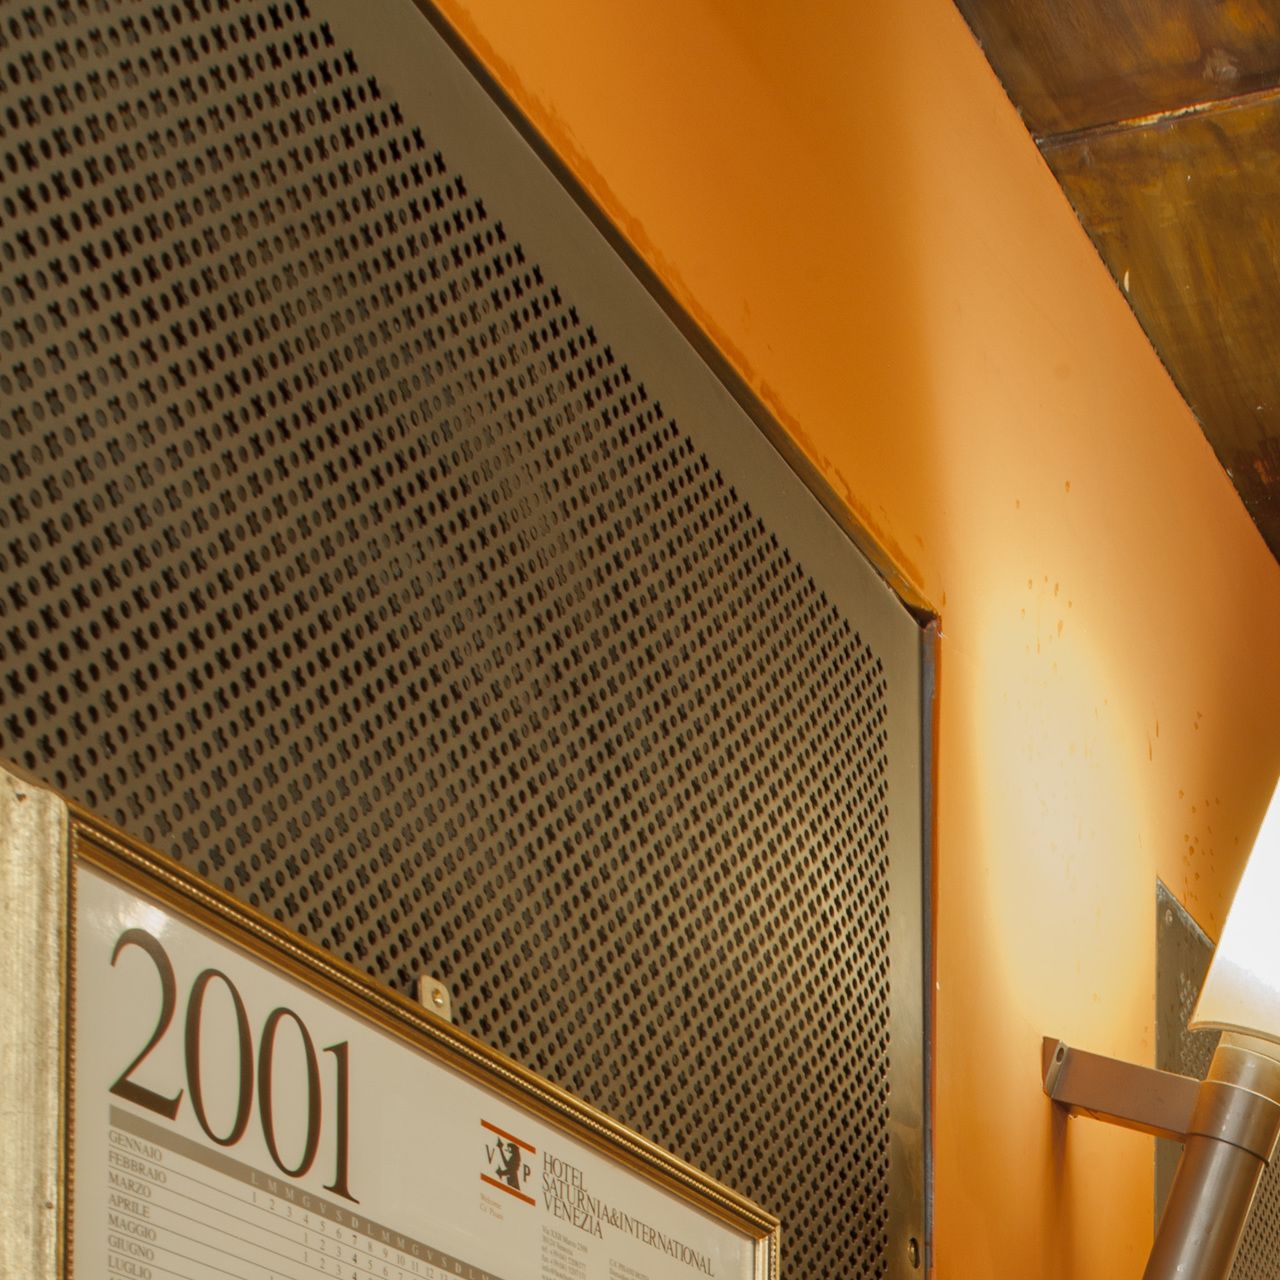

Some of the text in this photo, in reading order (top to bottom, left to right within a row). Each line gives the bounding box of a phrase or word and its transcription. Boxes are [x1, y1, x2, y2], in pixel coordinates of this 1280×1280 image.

[109, 927, 362, 1205] 2001
[109, 1130, 164, 1163] GENNAIO
[108, 1152, 168, 1185] FEBBRAIO
[544, 1151, 588, 1193] HOTEL
[108, 1172, 152, 1199] MARZO
[108, 1194, 151, 1219] APRILE
[544, 1191, 604, 1241] VENEZIA
[108, 1212, 158, 1242] MAGGIO
[107, 1235, 156, 1262] GIUGNO
